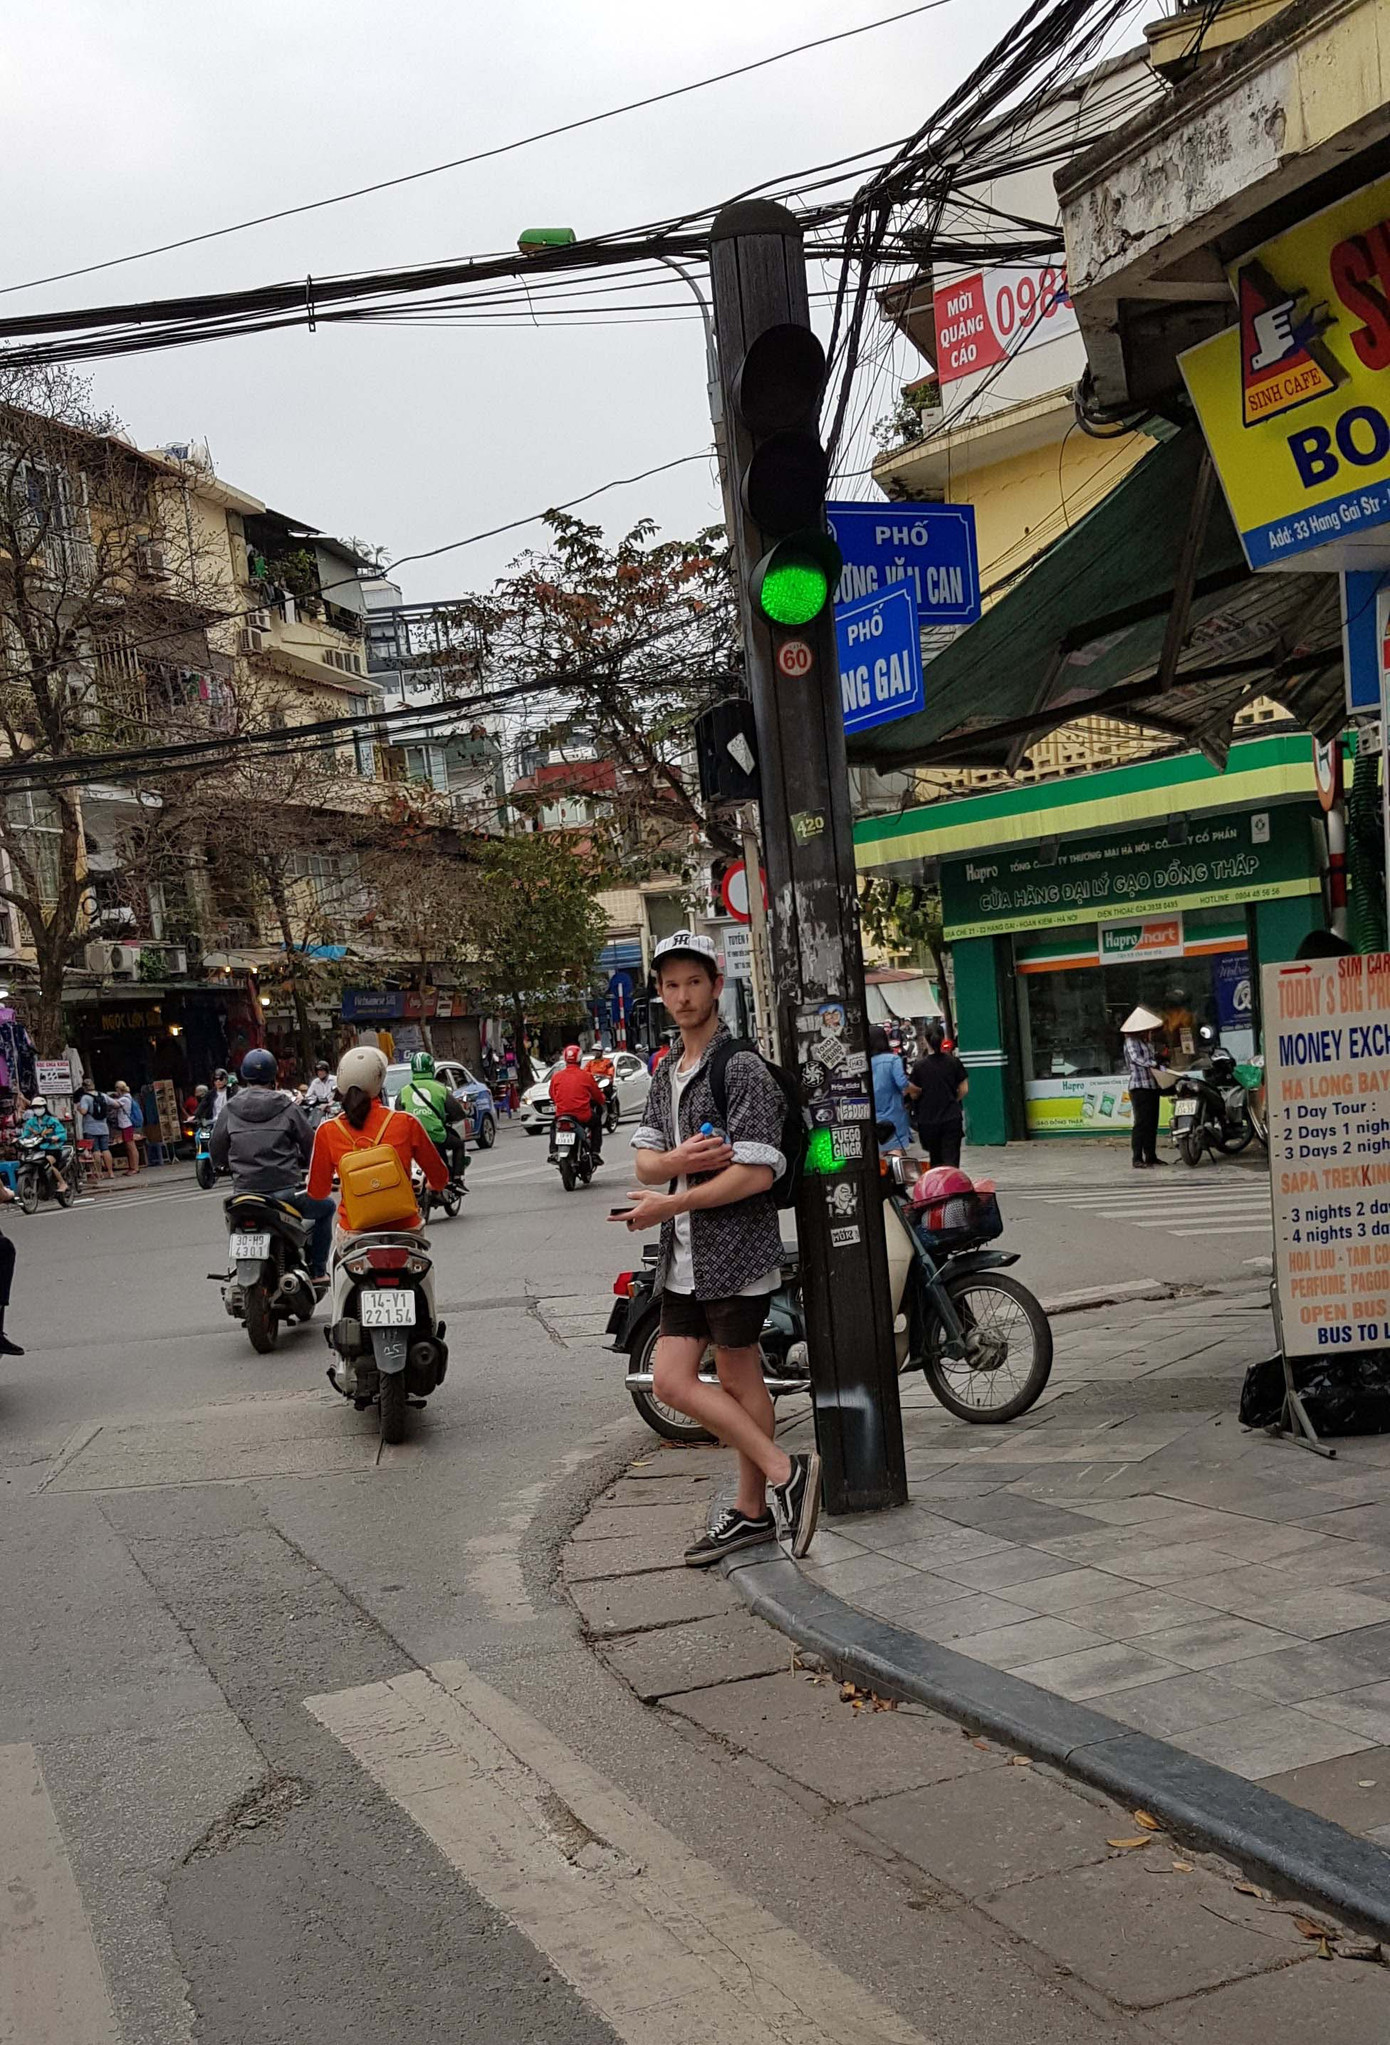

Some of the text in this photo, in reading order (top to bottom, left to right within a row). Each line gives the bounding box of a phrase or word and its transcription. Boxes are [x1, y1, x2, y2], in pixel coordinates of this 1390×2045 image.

[946, 291, 974, 318] MỜI
[940, 314, 985, 349] QUẢNG
[950, 343, 977, 368] CÁO
[1248, 367, 1322, 411] SINH CAFE
[875, 520, 929, 546] PHỐ
[1268, 495, 1380, 549] Add: 33 Hang Gai Str
[926, 566, 964, 605] CAN
[847, 603, 884, 646] PHỐ
[783, 648, 808, 670] 60
[874, 650, 912, 701] GAI
[797, 816, 825, 837] 420
[965, 864, 999, 883] Hapro
[1113, 872, 1151, 897] GẠO
[1338, 956, 1362, 978] SIM
[1340, 974, 1363, 1014] BIG
[1279, 1029, 1342, 1067] MONEY
[1282, 1069, 1390, 1101] HA LONG BAY
[1284, 1102, 1367, 1120] 1 Day Tour
[832, 1128, 861, 1145] FUEGO
[1284, 1128, 1292, 1140] 2
[1298, 1126, 1337, 1140] Days
[1343, 1122, 1350, 1135] 1
[834, 1142, 863, 1157] GINGR
[1285, 1147, 1294, 1160] 3
[1299, 1145, 1338, 1159] Days
[1343, 1141, 1351, 1154] 2
[1281, 1170, 1319, 1195] SAPA
[1291, 1208, 1300, 1222] 3
[1305, 1204, 1351, 1223] nights
[1356, 1201, 1365, 1216] 2
[1292, 1229, 1301, 1243] 4
[1306, 1225, 1353, 1244] nights
[1357, 1223, 1366, 1237] 3
[236, 1246, 263, 1257] 4301
[1288, 1251, 1311, 1273] HOA
[1314, 1249, 1337, 1271] LUU
[1346, 1245, 1371, 1268] TAM
[1290, 1274, 1347, 1299] PERFUME
[365, 1309, 412, 1325] 221.54
[1300, 1298, 1387, 1325] OPEN BUS
[1318, 1325, 1352, 1344] BUS
[1358, 1323, 1378, 1342] TO
